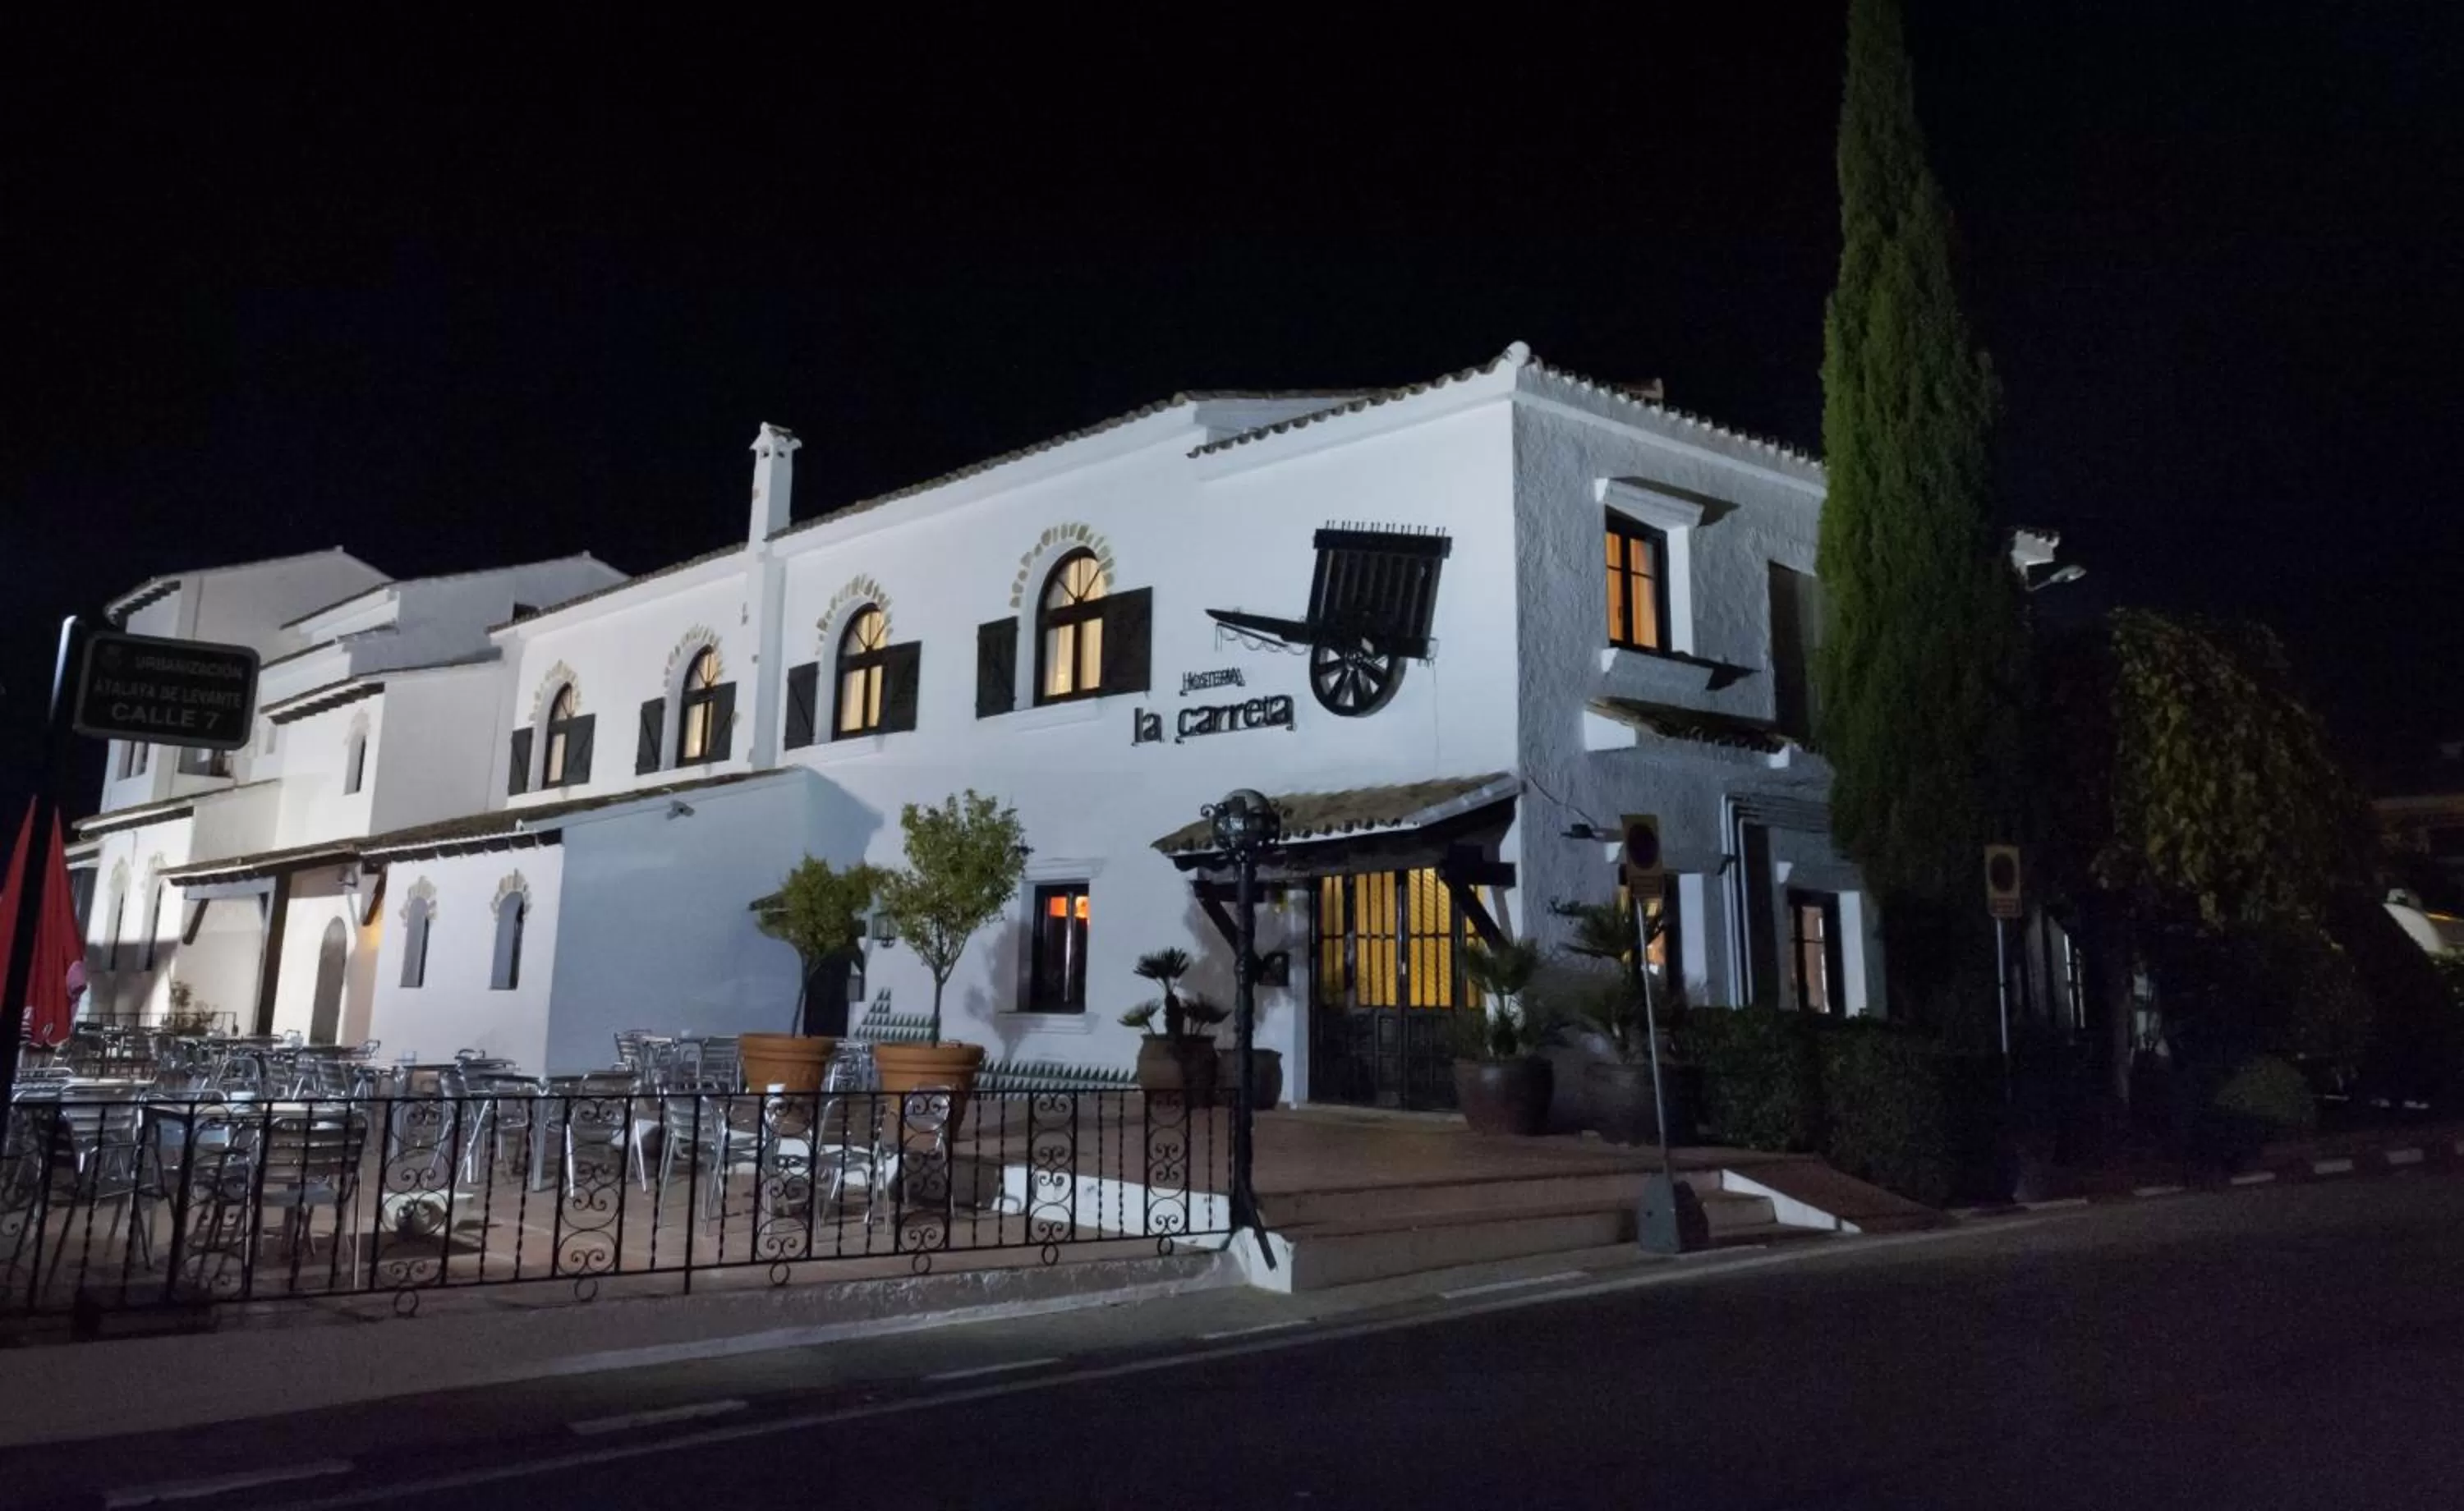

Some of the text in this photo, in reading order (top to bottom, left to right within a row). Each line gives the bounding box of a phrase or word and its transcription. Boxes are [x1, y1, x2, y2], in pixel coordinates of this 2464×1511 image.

[159, 685, 179, 701] DE
[111, 701, 221, 730] CALLE 7
